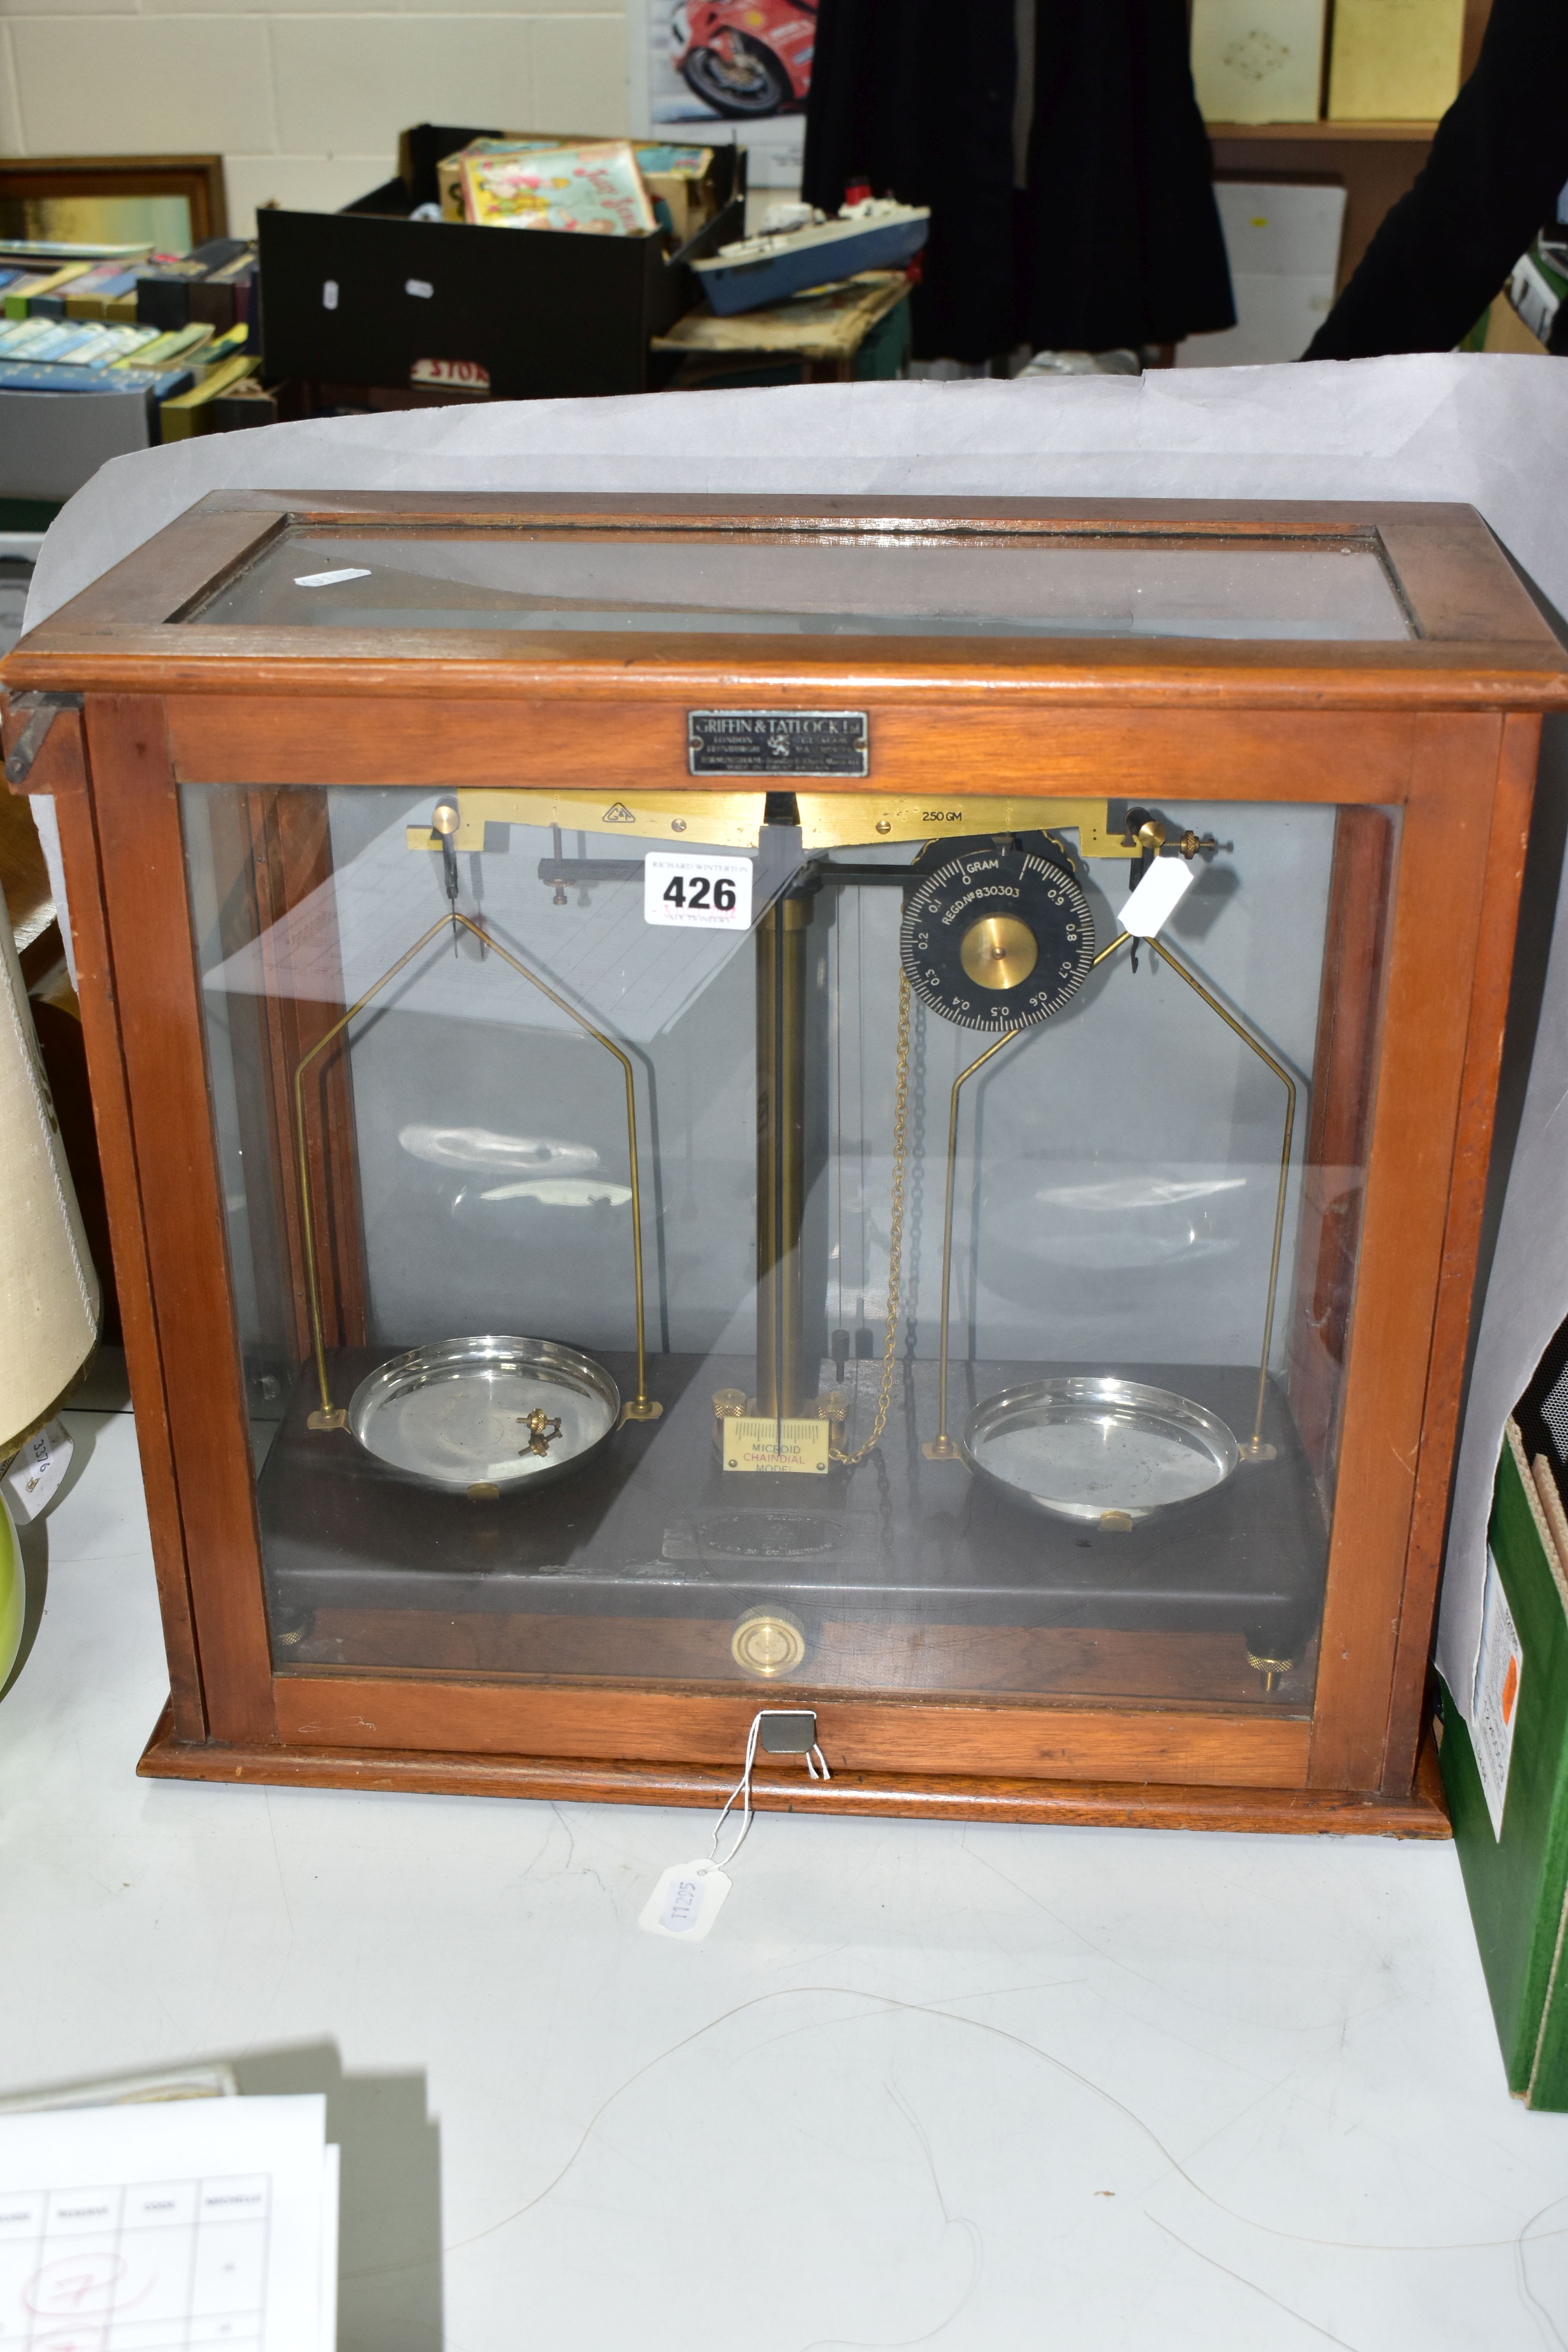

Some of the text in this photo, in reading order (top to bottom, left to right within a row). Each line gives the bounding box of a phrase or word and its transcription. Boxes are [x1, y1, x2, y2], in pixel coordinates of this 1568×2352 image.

[696, 719, 751, 733] GRIFFIN
[755, 720, 766, 733] &
[768, 720, 838, 734] TATLOCK
[922, 812, 962, 821] 250 GM
[652, 862, 748, 872] RICHARD WINTERTON
[967, 859, 999, 873] GRAM
[962, 876, 971, 885] 0
[663, 876, 736, 911] 426
[1047, 889, 1064, 906] 0.9
[929, 900, 942, 913] 0.1
[1066, 924, 1077, 941] 0.8
[918, 932, 928, 949] 0.2
[1058, 962, 1071, 978] 0.7
[926, 969, 940, 986] 0.3
[953, 996, 970, 1010] 0.4
[1029, 992, 1047, 1006] 0.6
[991, 1007, 1009, 1016] 0.5
[34, 1439, 51, 1472] 3376
[752, 1444, 800, 1454] MICROID
[743, 1453, 805, 1464] CHAINDIAL
[671, 1882, 696, 1918] 11295
